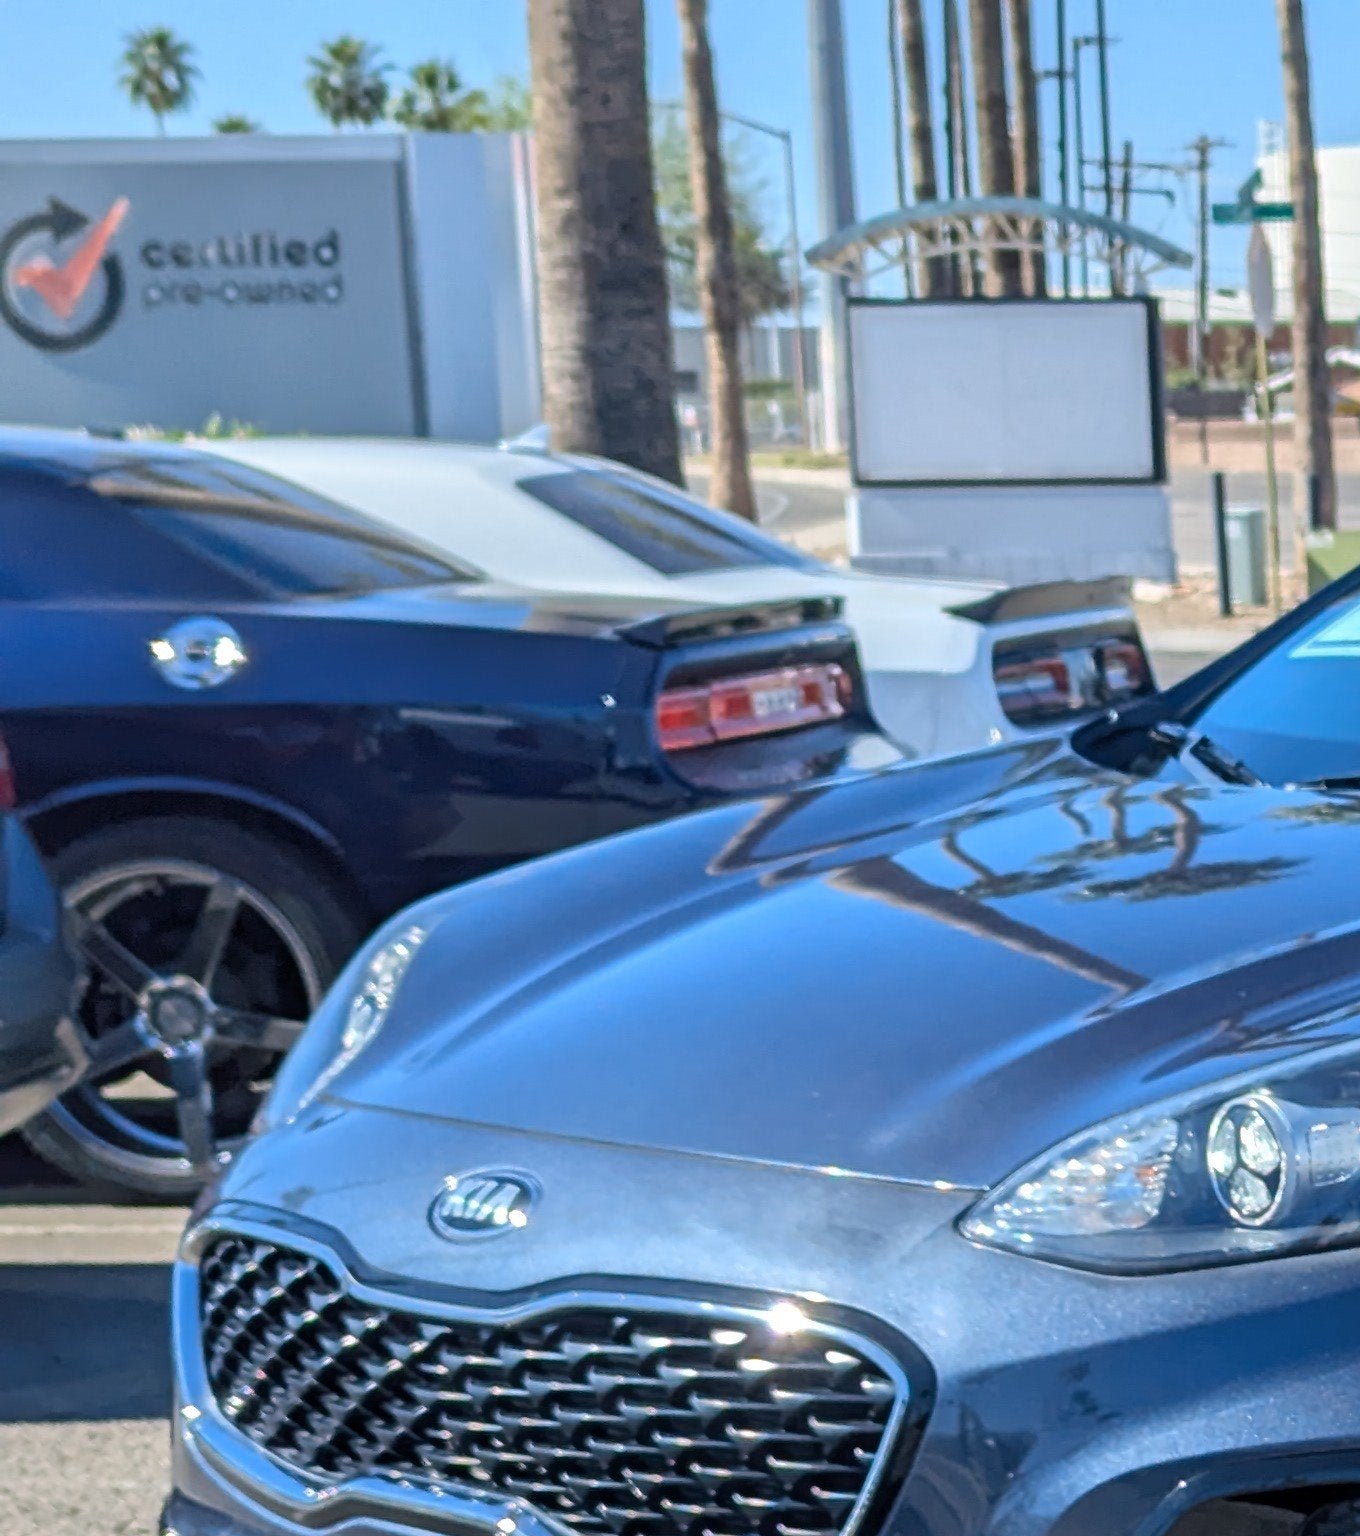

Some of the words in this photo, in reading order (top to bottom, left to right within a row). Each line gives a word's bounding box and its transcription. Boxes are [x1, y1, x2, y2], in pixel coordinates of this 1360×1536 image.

[139, 228, 340, 270] certified
[143, 273, 344, 309] pre-owned
[440, 1178, 522, 1225] KIA
